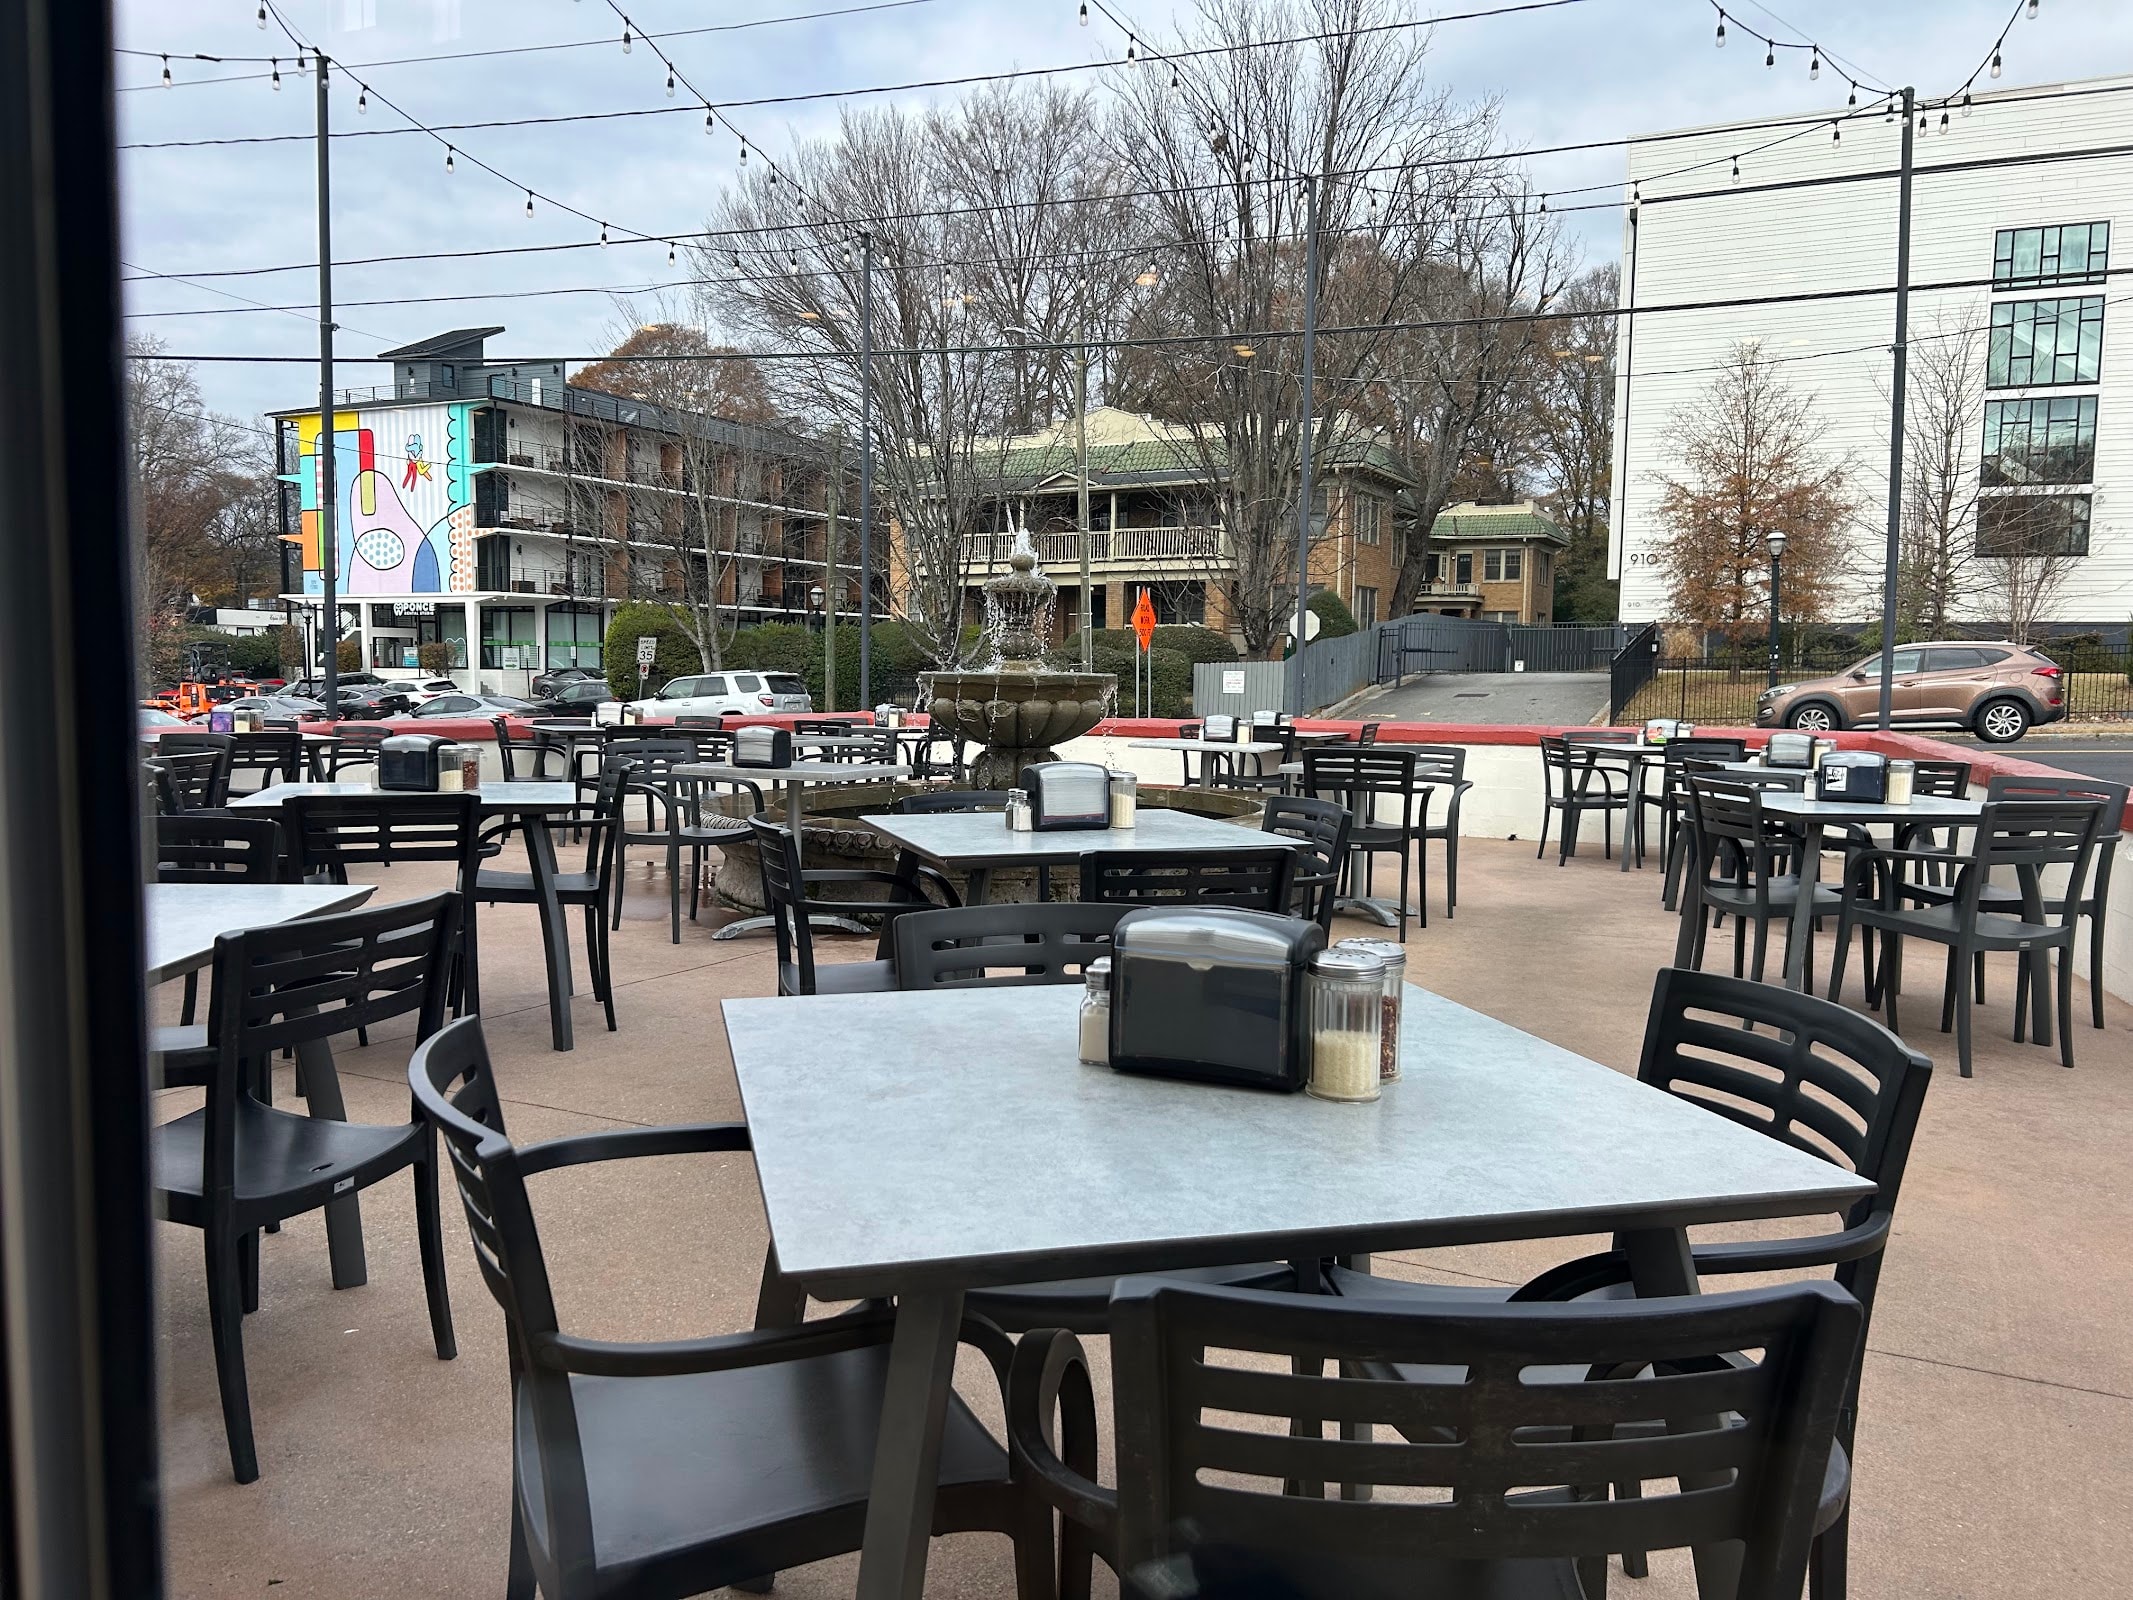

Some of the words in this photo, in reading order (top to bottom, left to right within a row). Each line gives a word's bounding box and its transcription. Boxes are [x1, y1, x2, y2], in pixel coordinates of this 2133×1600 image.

[1630, 553, 1657, 565] 910
[403, 602, 435, 611] PONCE
[639, 650, 653, 660] 35
